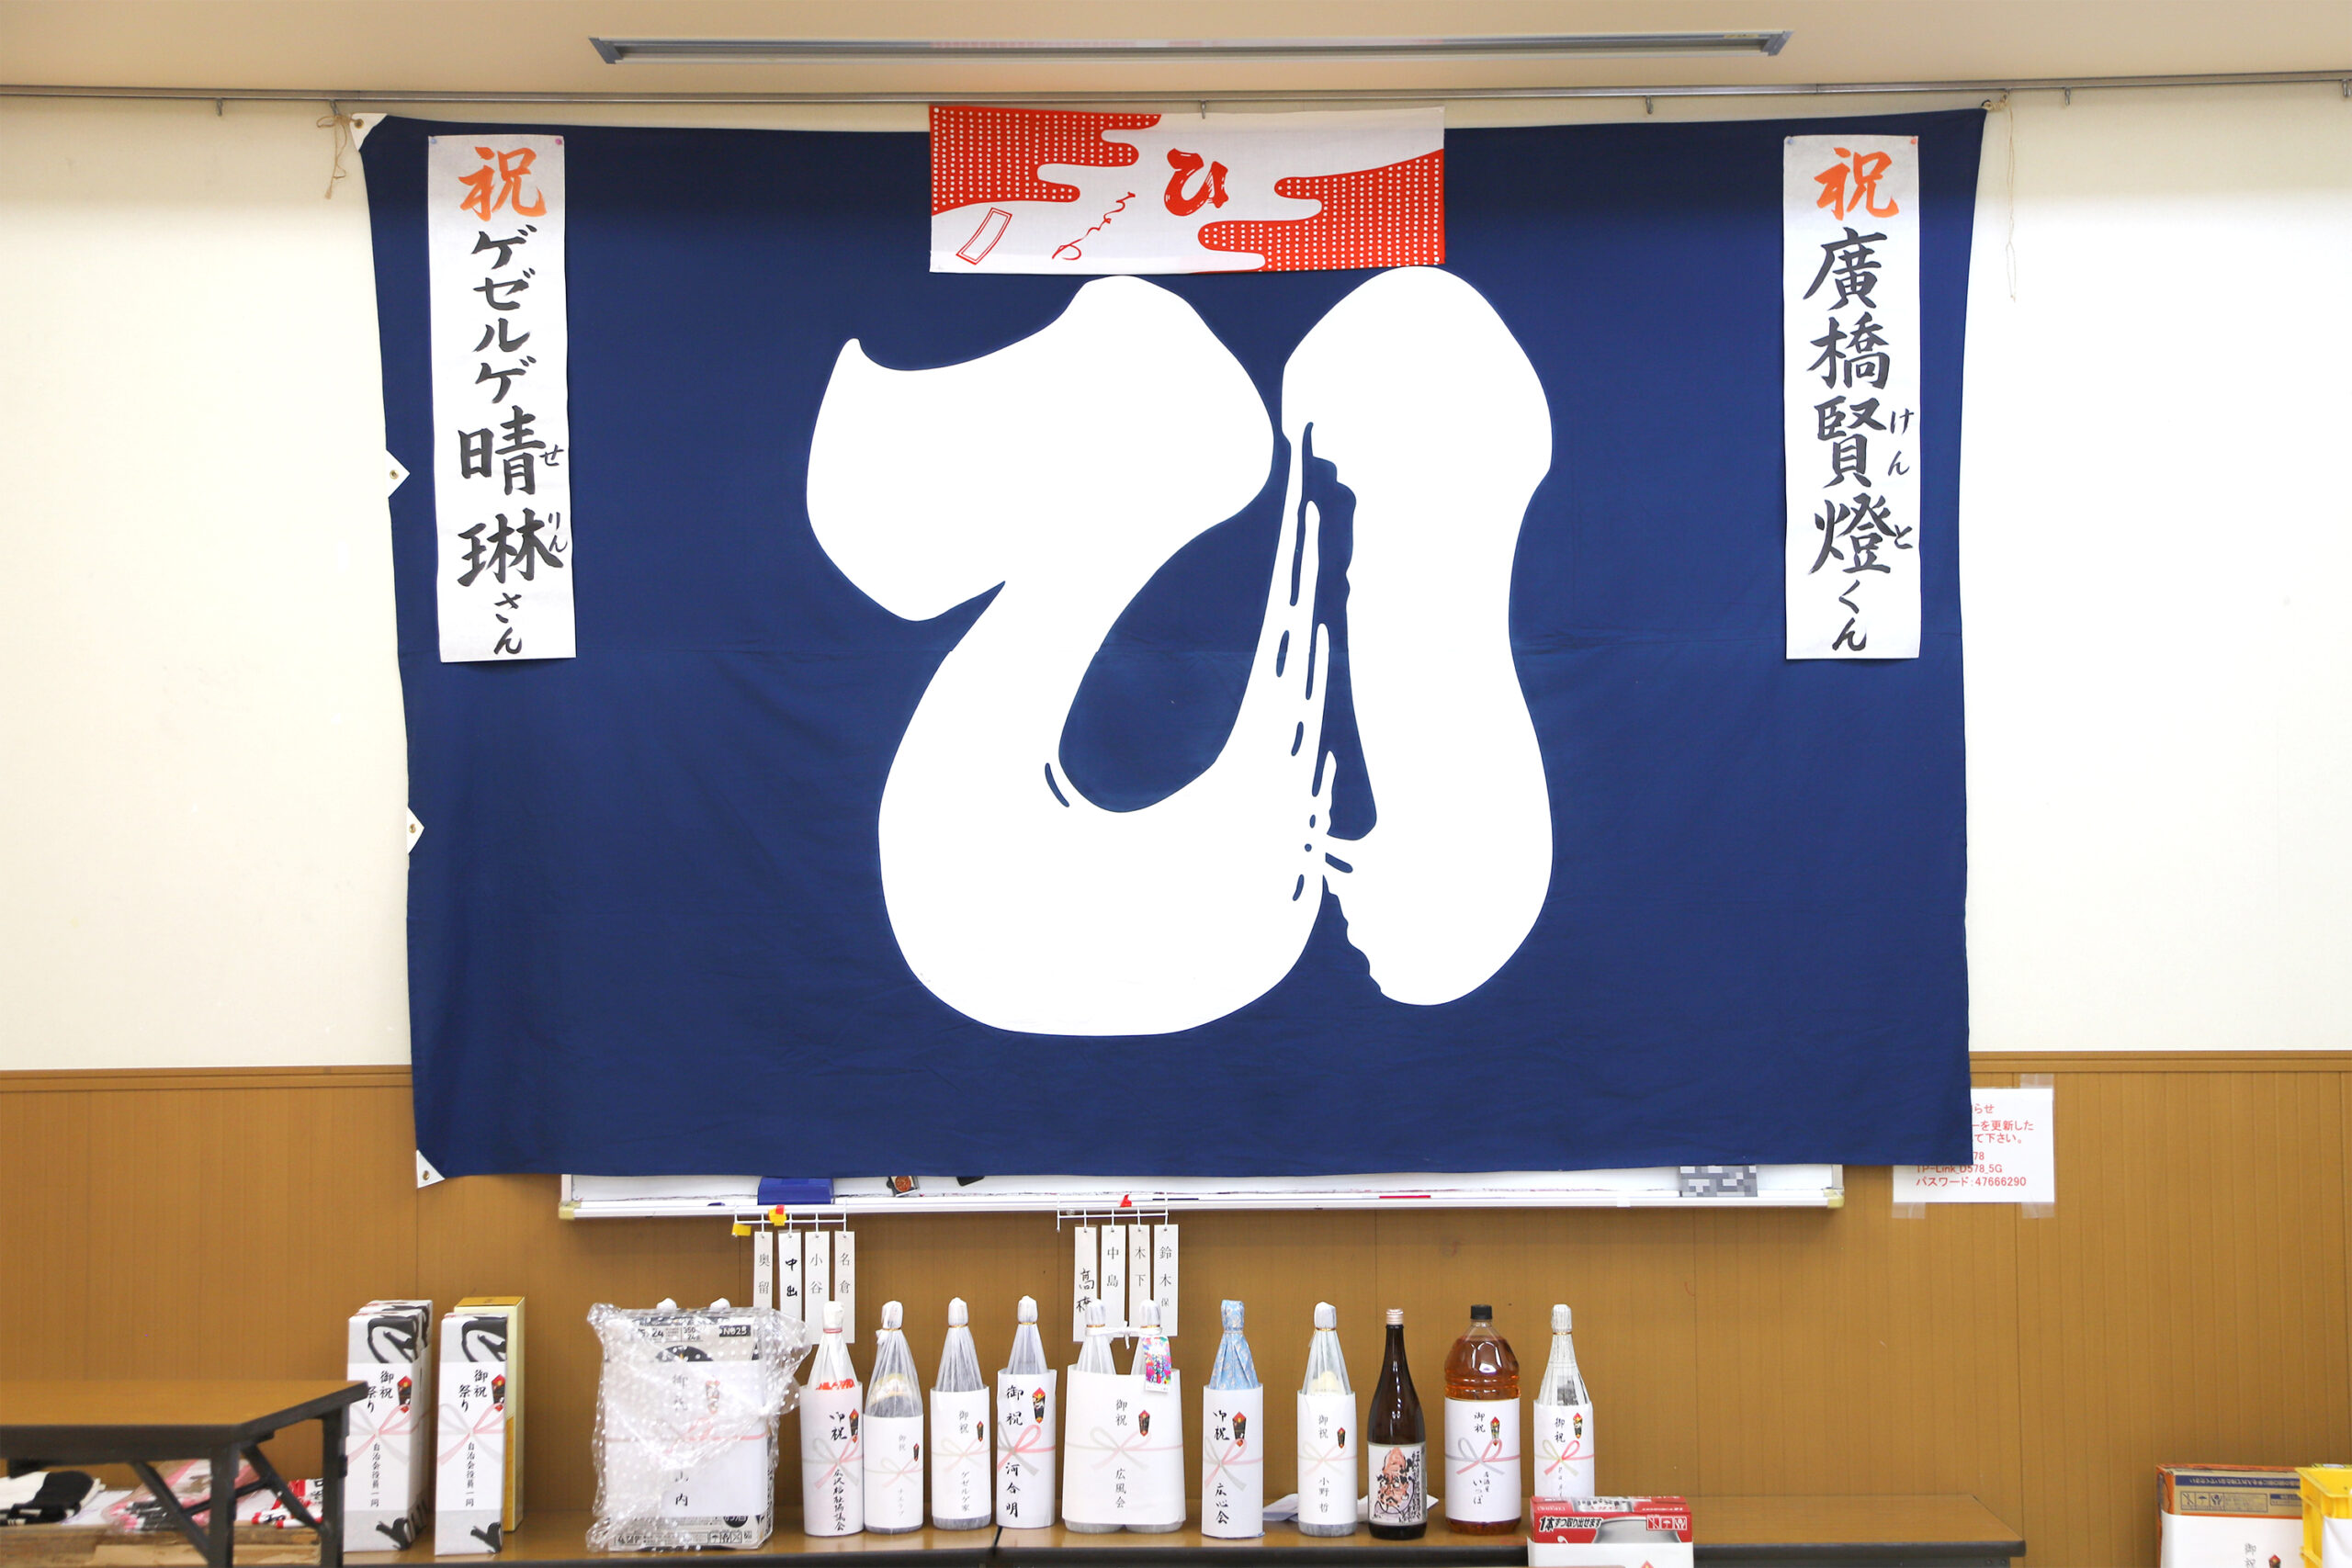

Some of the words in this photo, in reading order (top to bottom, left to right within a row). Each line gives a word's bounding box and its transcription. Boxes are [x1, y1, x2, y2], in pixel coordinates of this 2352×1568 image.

[458, 145, 548, 221] 祝
[1164, 148, 1230, 217] ひ
[1813, 147, 1899, 221] 祝
[457, 224, 563, 656] ゲゼルゲ晴琳さん
[1803, 227, 1896, 653] 廣橋賢燈くん
[807, 266, 1555, 1038] ひ
[1972, 1103, 1995, 1114] らせ
[810, 1253, 823, 1295] 小谷
[840, 1253, 851, 1294] 名倉
[1106, 1247, 1119, 1288] 中島
[1135, 1247, 1146, 1287] 木下
[379, 1370, 394, 1399] 御祝
[458, 1384, 471, 1413] 祭り
[473, 1369, 489, 1398] 御祝
[958, 1410, 970, 1434] 御祝
[1006, 1384, 1023, 1426] 御祝
[1115, 1399, 1127, 1426] 御祝
[1474, 1411, 1486, 1434] 御祝
[1318, 1415, 1329, 1438] 御祝
[1555, 1416, 1566, 1443] 御祝
[1005, 1461, 1021, 1518] 河合明
